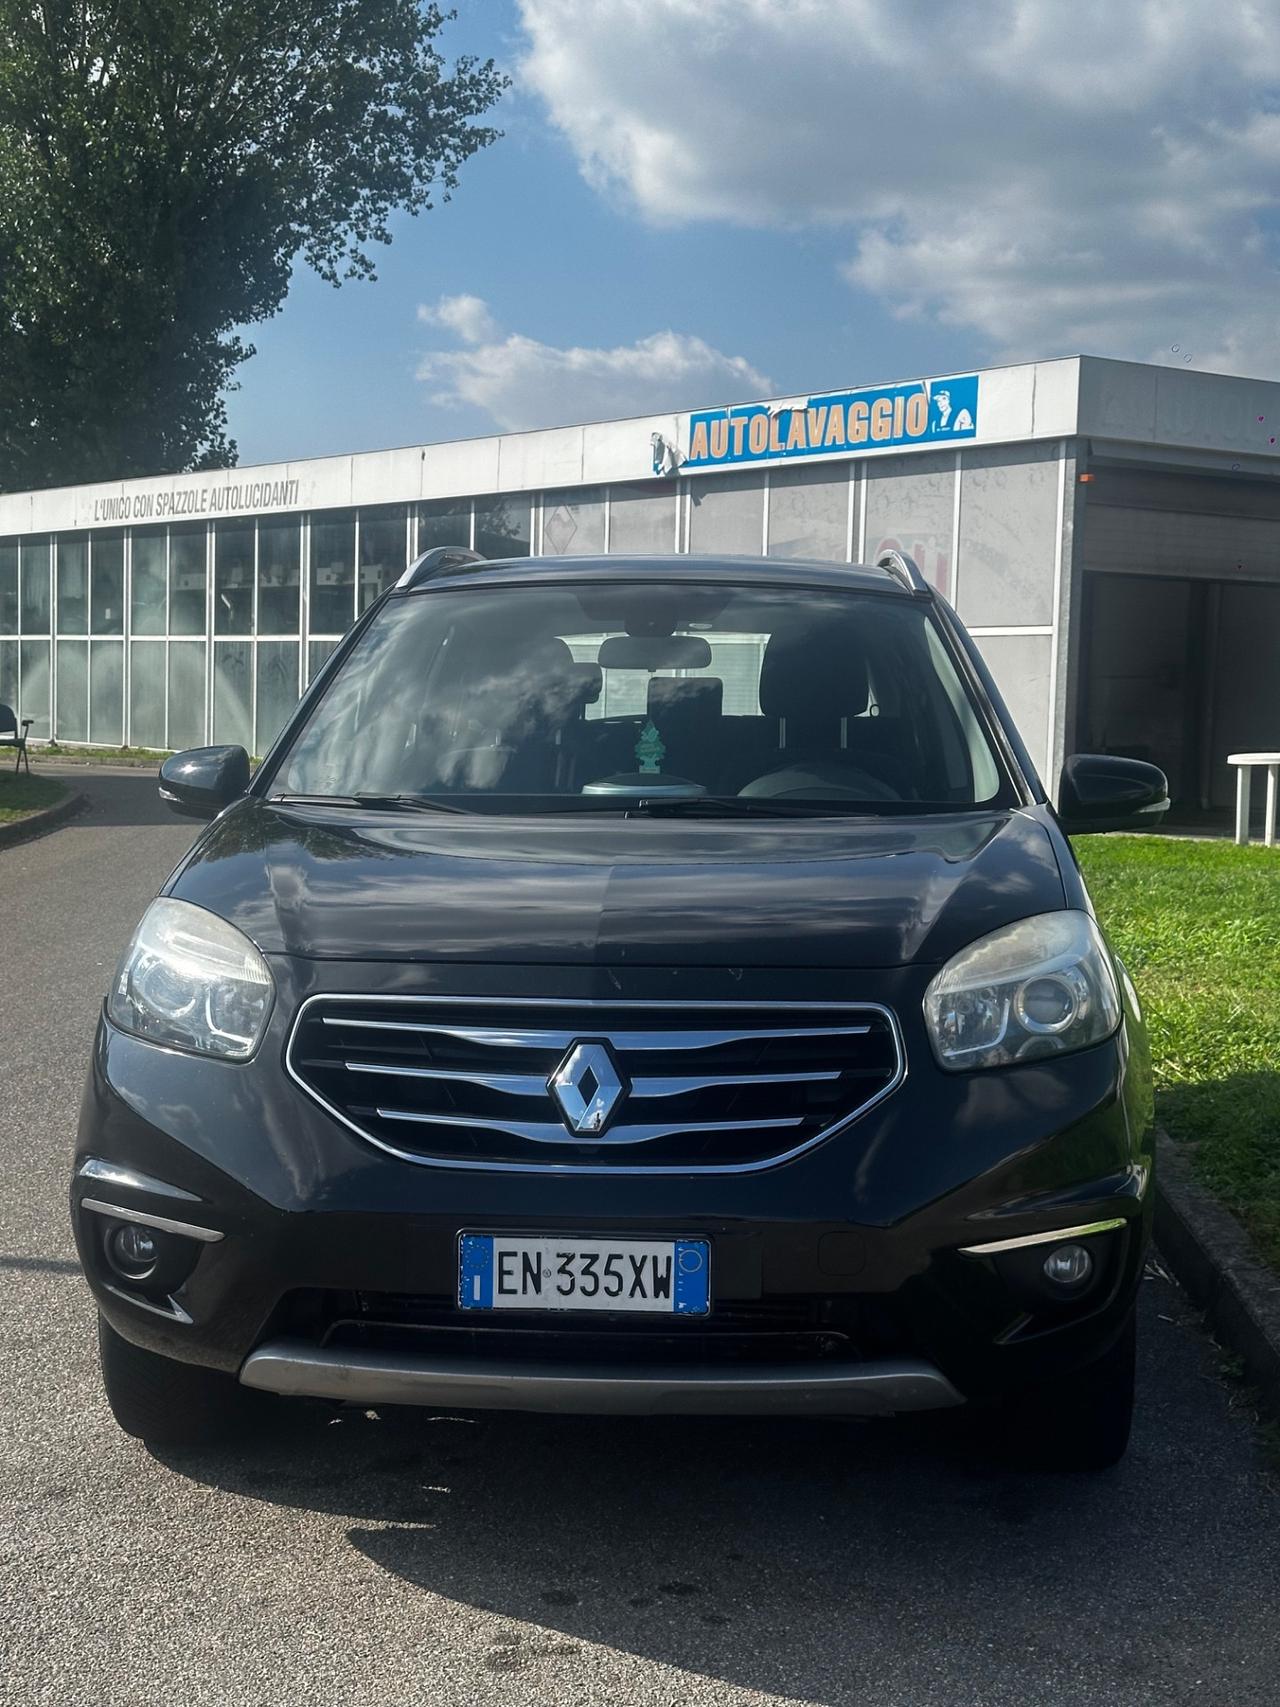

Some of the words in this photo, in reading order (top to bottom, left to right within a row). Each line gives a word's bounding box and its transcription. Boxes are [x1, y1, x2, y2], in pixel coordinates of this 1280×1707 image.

[690, 392, 929, 460] AUTOLAVAGGIO
[94, 496, 131, 522] L'UNICO
[133, 494, 154, 519] CON
[155, 488, 209, 517] SPAZZOLE
[209, 479, 300, 513] AUTOLUCIDANTI
[498, 1251, 542, 1295] EN
[556, 1252, 672, 1299] 335XW
